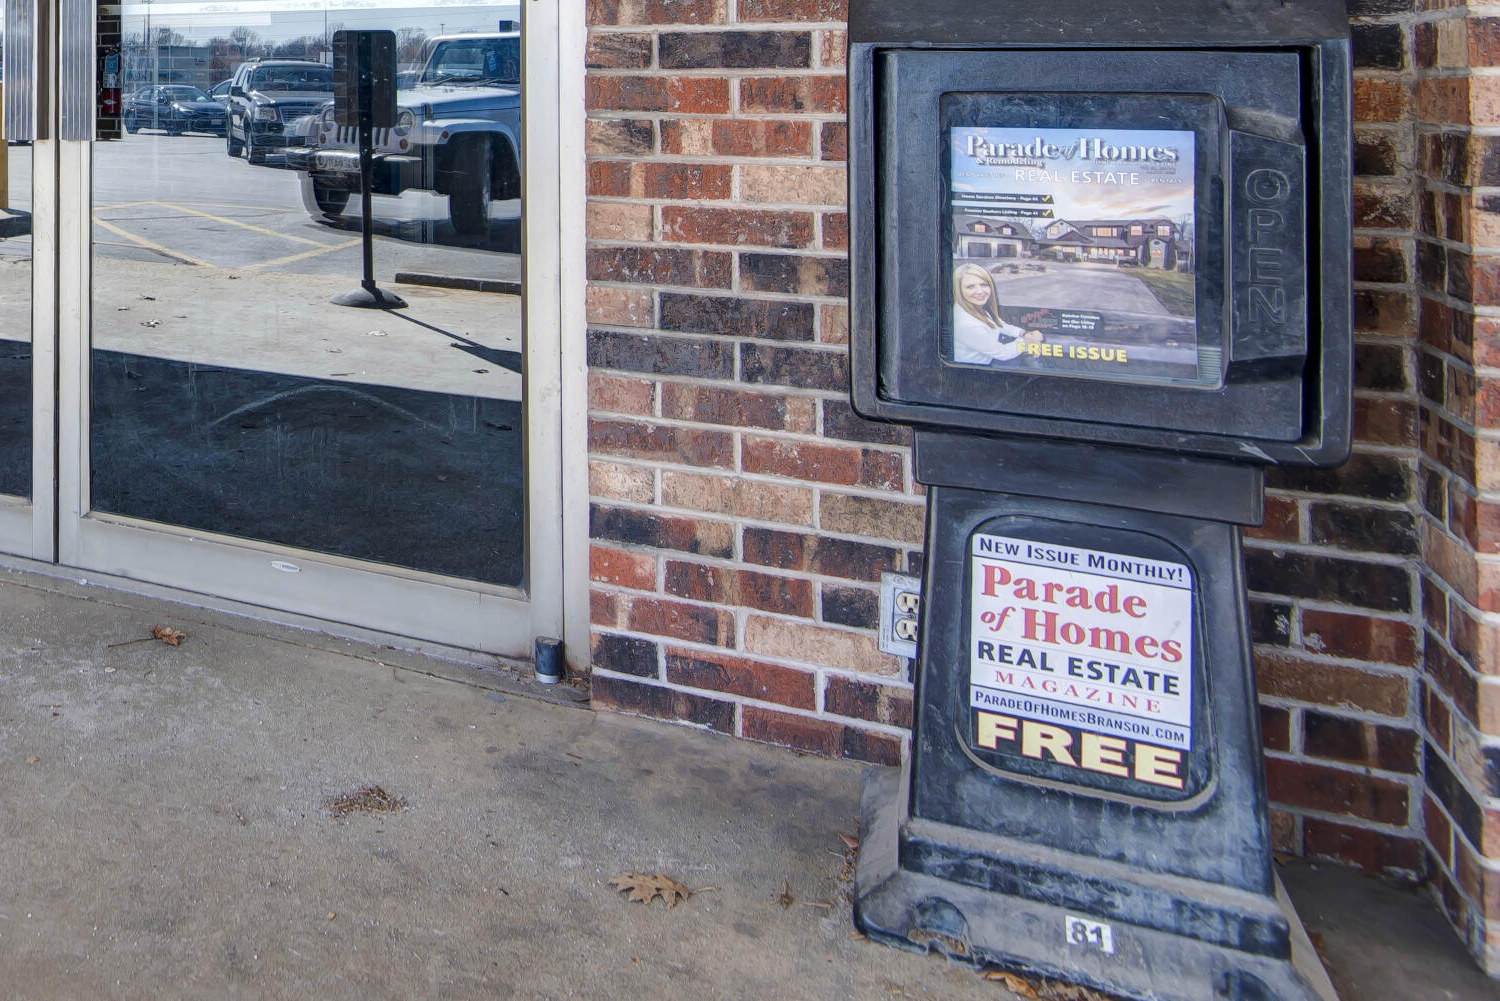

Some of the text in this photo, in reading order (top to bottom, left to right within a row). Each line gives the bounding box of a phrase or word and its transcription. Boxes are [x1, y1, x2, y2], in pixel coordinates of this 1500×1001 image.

[966, 135, 1056, 159] Parade
[1079, 137, 1179, 162] Homes
[985, 157, 1044, 168] Remodeling
[1015, 169, 1061, 182] REAL
[1071, 170, 1140, 185] ESTATE
[1245, 168, 1291, 326] OPEN
[1017, 342, 1128, 363] FREE ISSUE
[980, 537, 1184, 582] NEW ISSUE MONTHLY!
[981, 564, 1148, 618] Parade
[980, 606, 1183, 663] of Homes
[978, 640, 1181, 696] REAL ESTATE
[995, 670, 1162, 714] MAGAZINE
[977, 711, 1185, 790] FREE
[1071, 921, 1104, 949] 81
